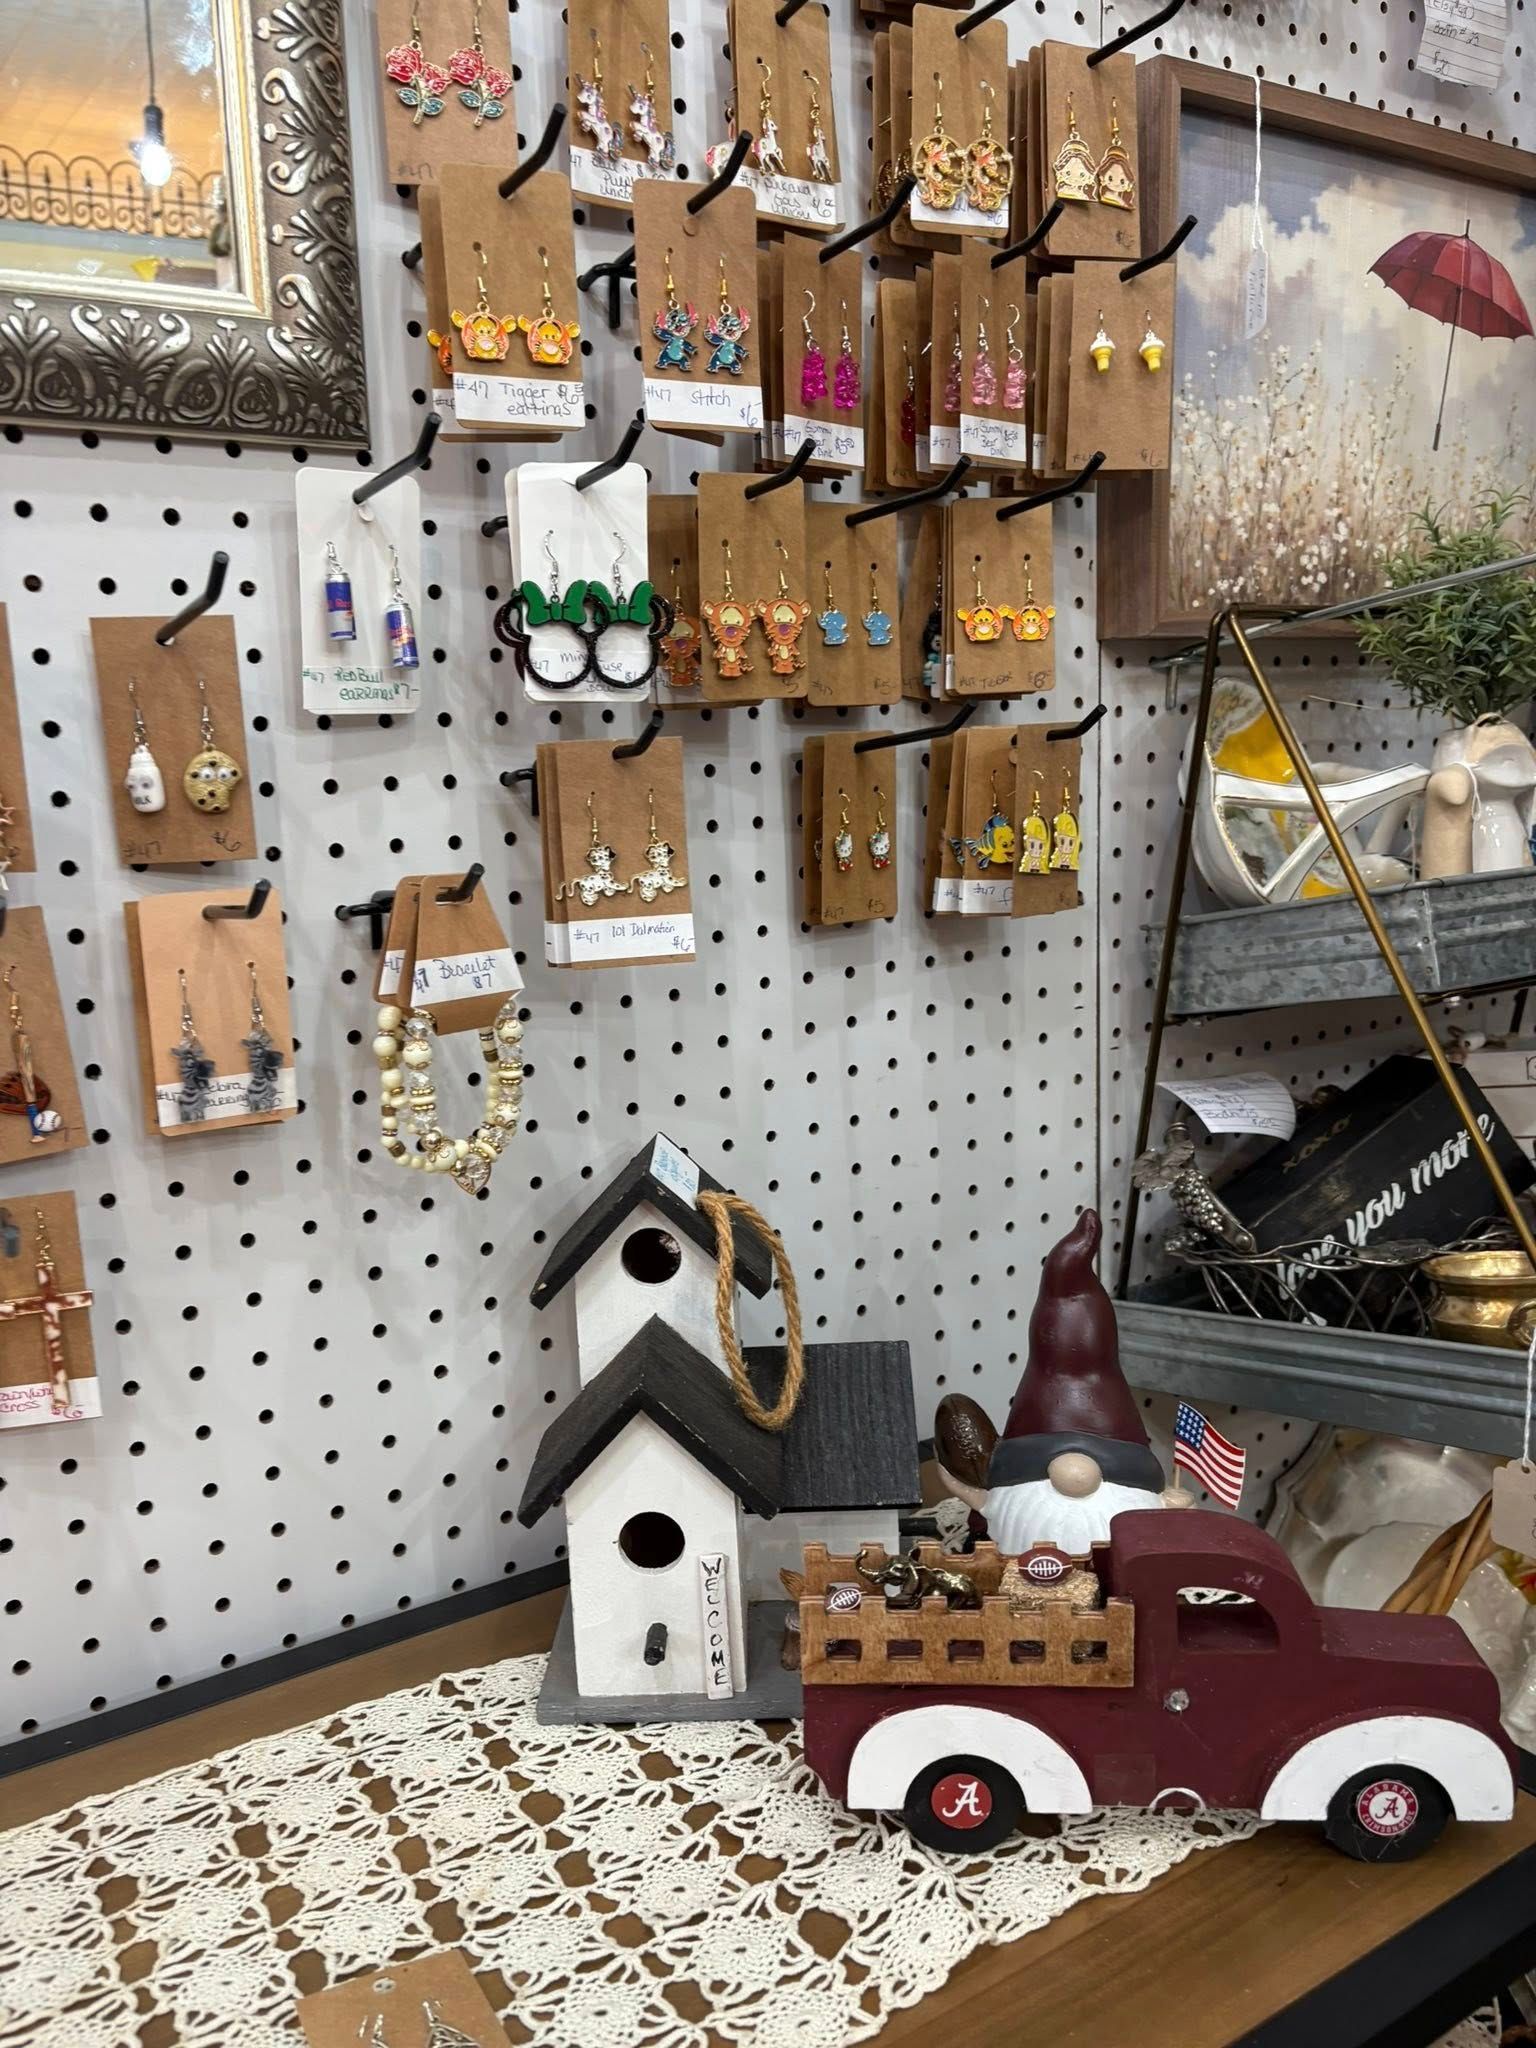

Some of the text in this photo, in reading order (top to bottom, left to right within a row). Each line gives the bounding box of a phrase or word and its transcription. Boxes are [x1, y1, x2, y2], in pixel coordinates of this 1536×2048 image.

[1345, 1182, 1407, 1247] you
[1410, 1112, 1496, 1195] more
[942, 1781, 982, 1818] A
[1361, 1783, 1414, 1806] ALABAMA
